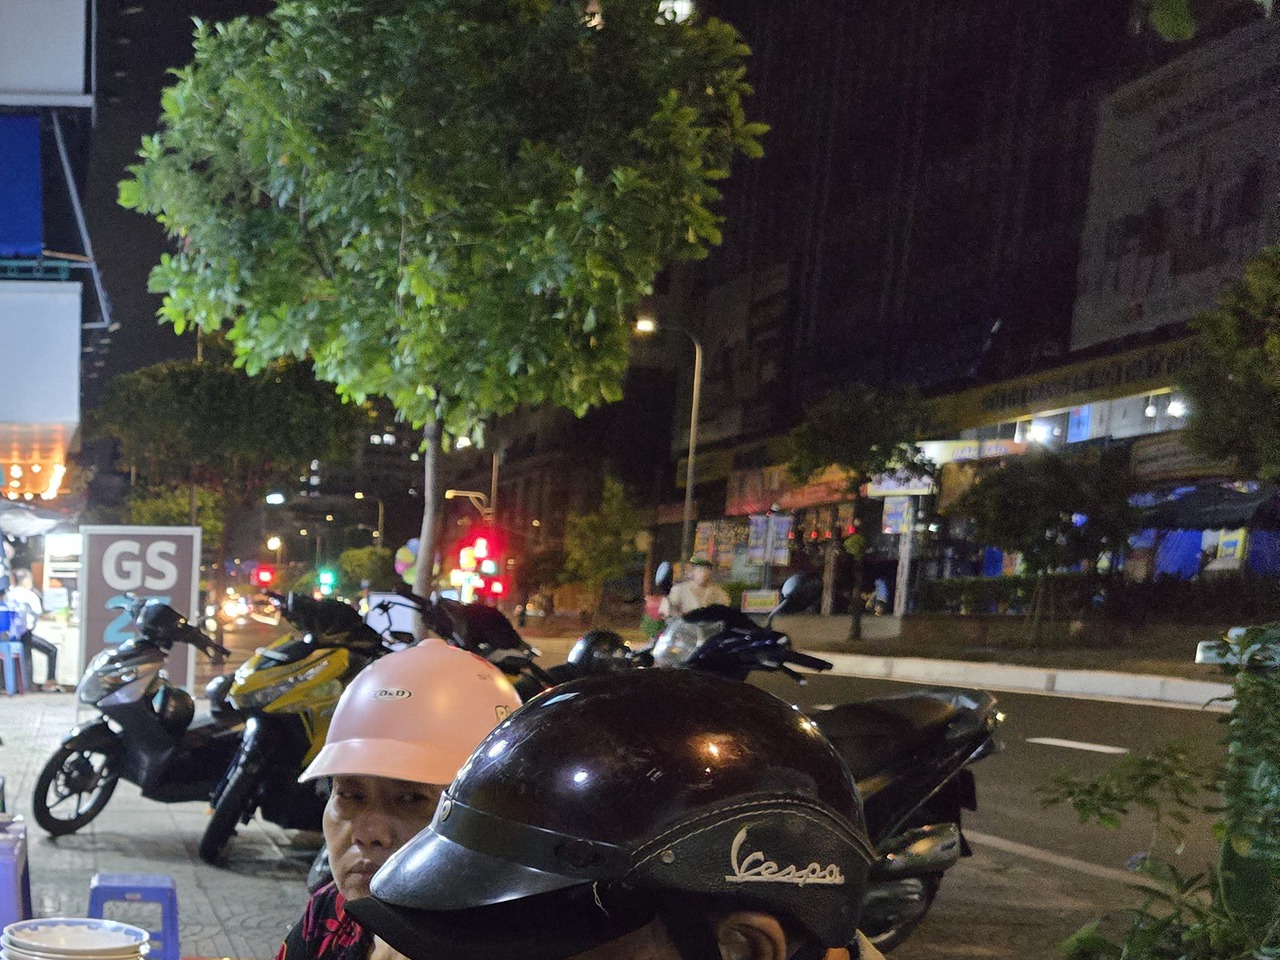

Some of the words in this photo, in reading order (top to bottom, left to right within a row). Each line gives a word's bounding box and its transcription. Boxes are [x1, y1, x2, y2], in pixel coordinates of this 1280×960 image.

[102, 540, 178, 591] GS
[104, 594, 172, 644] 2
[725, 827, 845, 887] Vespa
